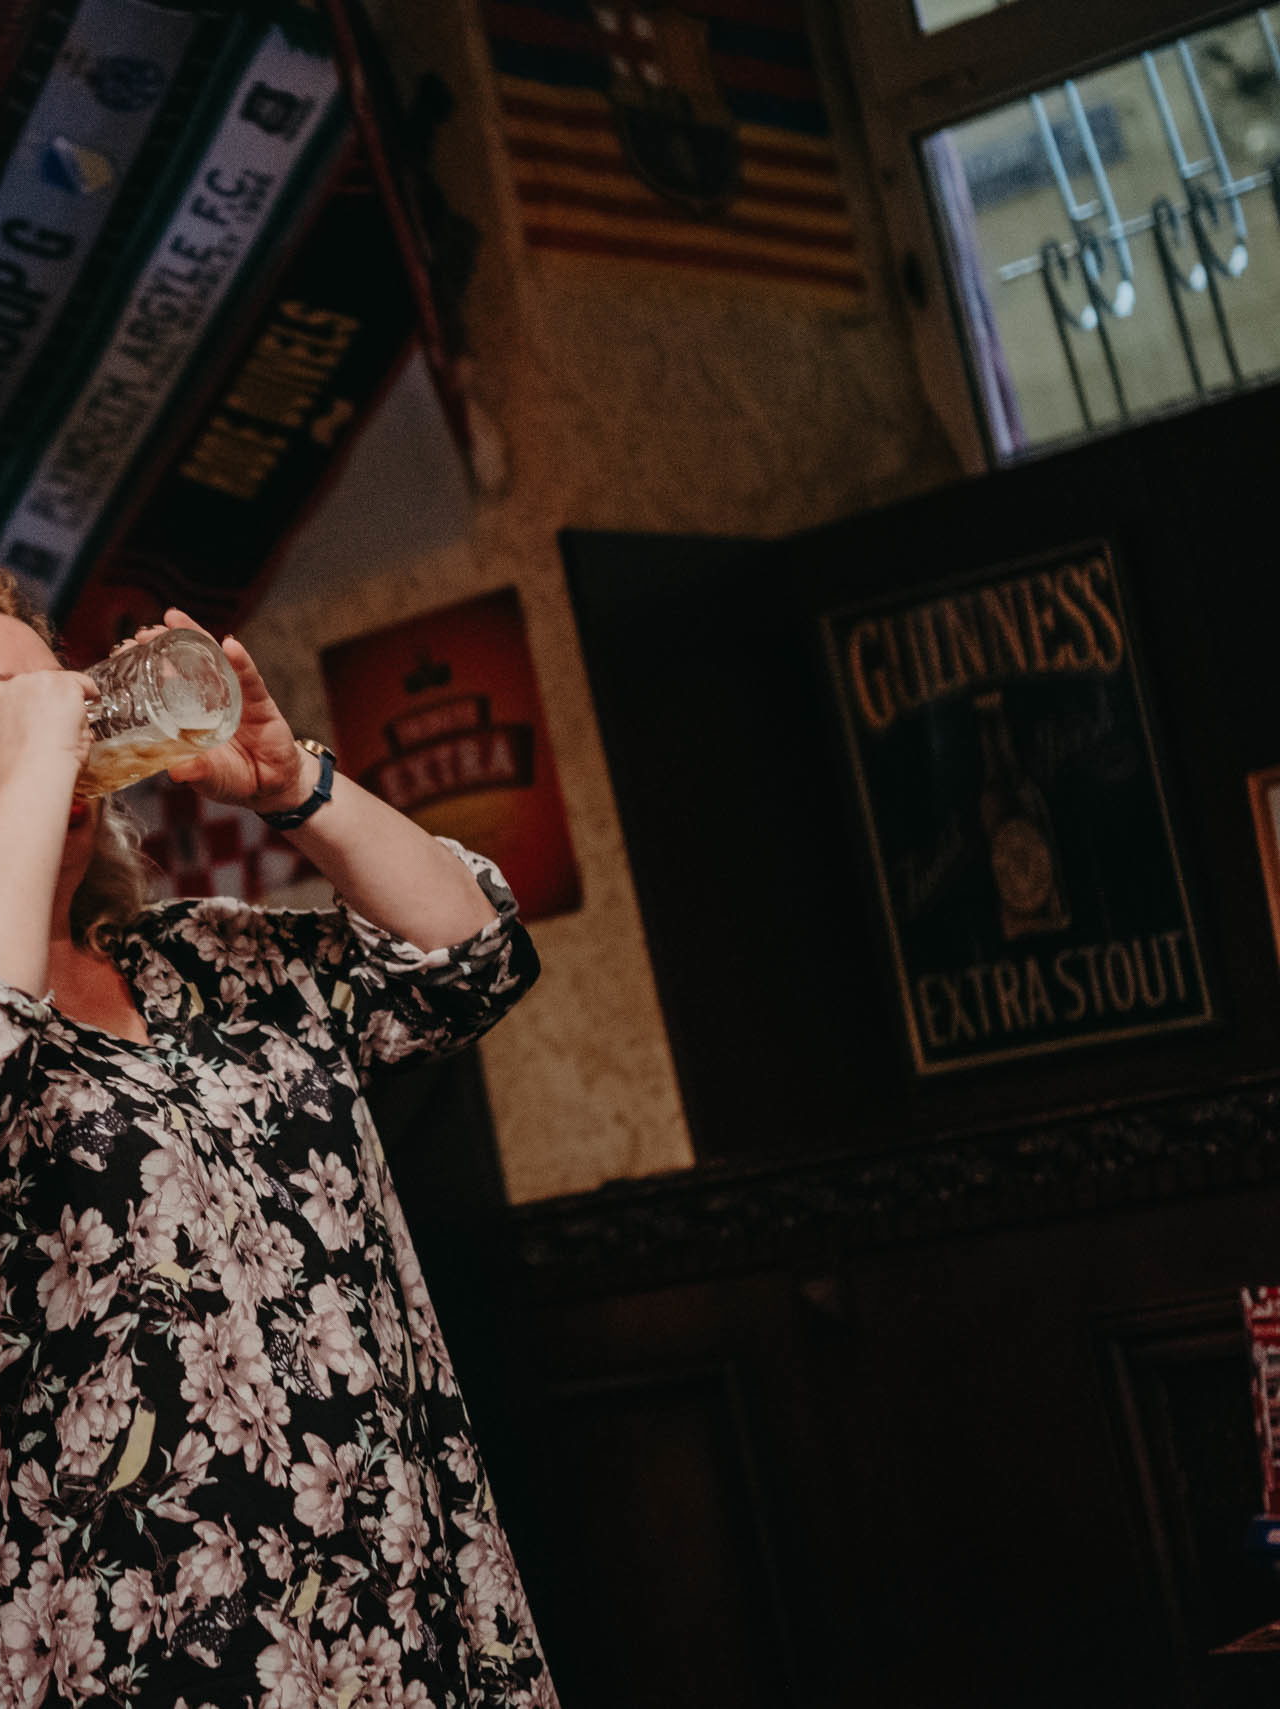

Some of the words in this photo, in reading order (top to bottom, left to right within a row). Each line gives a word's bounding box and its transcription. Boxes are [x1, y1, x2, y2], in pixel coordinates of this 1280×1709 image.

[0, 215, 76, 262] G
[848, 557, 1122, 731] GUINNESS
[915, 953, 1055, 1048] EXTRA
[1053, 930, 1189, 1022] STOUT
